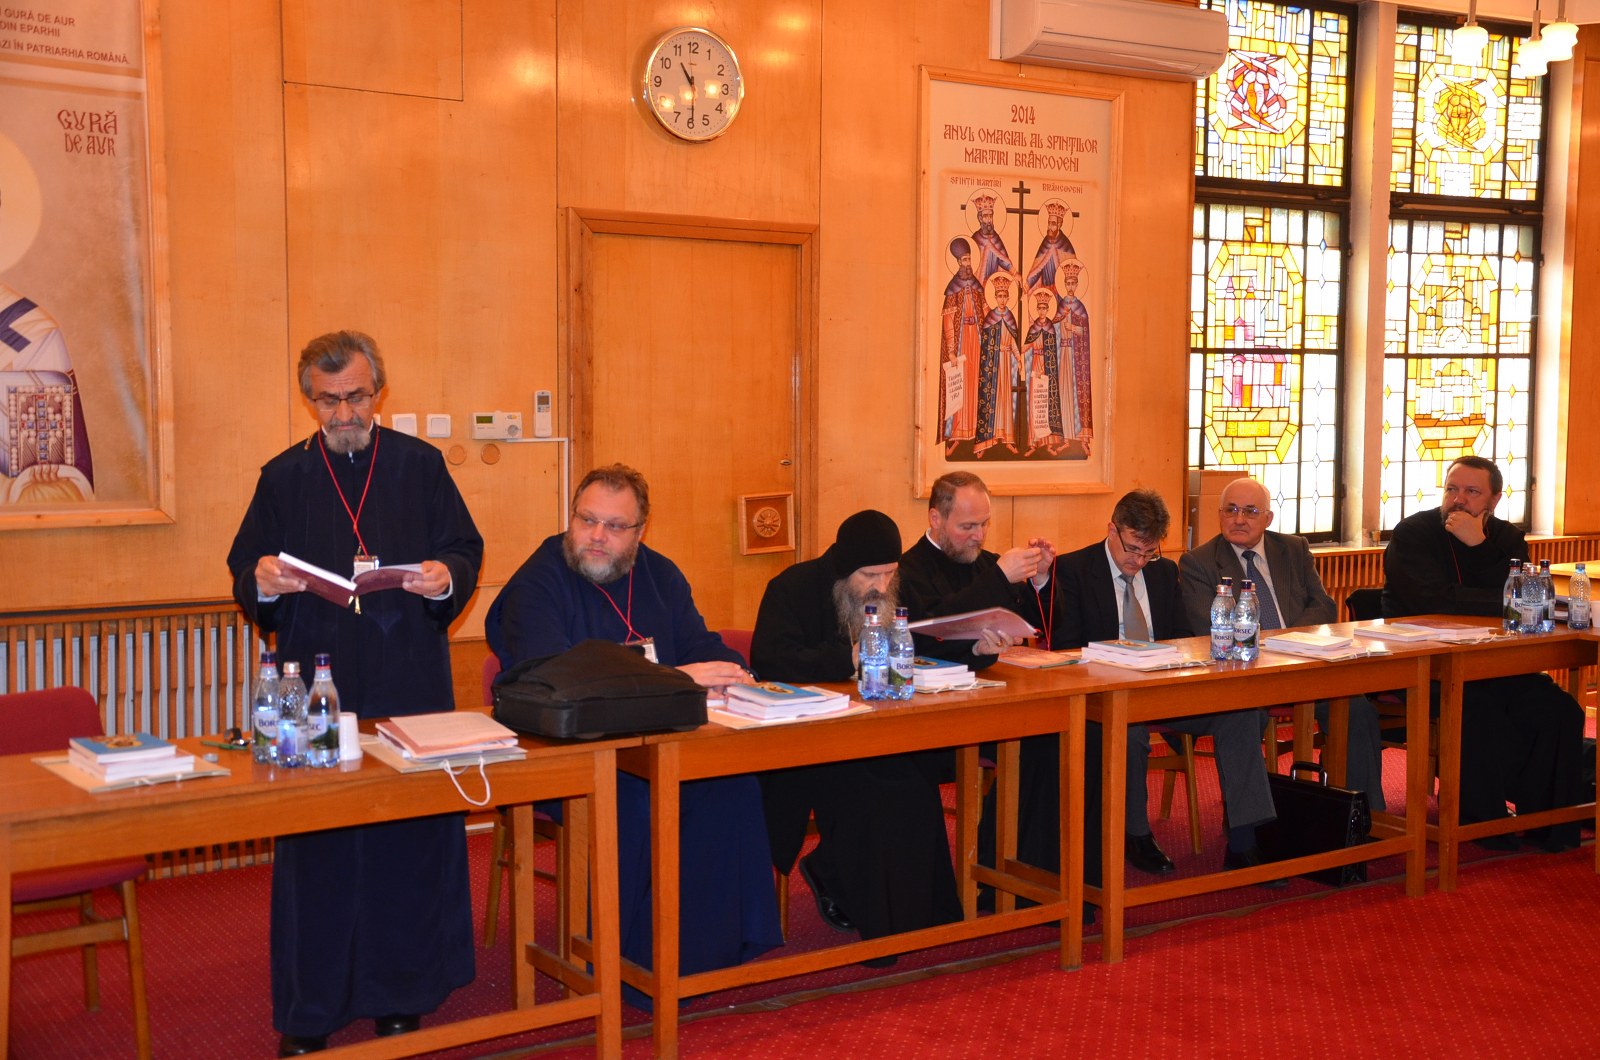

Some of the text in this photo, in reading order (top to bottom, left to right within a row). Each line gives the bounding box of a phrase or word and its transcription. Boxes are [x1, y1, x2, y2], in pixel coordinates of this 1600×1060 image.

[38, 13, 51, 23] DE
[54, 16, 75, 26] AUR
[0, 20, 60, 37] DIN EPARHII
[13, 39, 23, 51] ÎN
[27, 43, 84, 58] PATRIARHIA
[87, 51, 128, 64] ROMÂNĂ
[673, 44, 682, 56] 11
[688, 42, 699, 54] 12
[706, 49, 711, 60] 1
[660, 57, 671, 69] 10
[717, 64, 725, 76] 2
[654, 76, 662, 87] 9
[721, 84, 729, 95] 3
[715, 103, 723, 114] 4
[1011, 104, 1036, 125] 2014
[674, 111, 681, 123] 7
[687, 117, 695, 129] 6
[702, 114, 710, 126] 5
[978, 128, 1027, 147] OMAGIAL
[1030, 133, 1043, 148] AL
[964, 147, 1079, 173] MARTIRI BRÂNCOVENI
